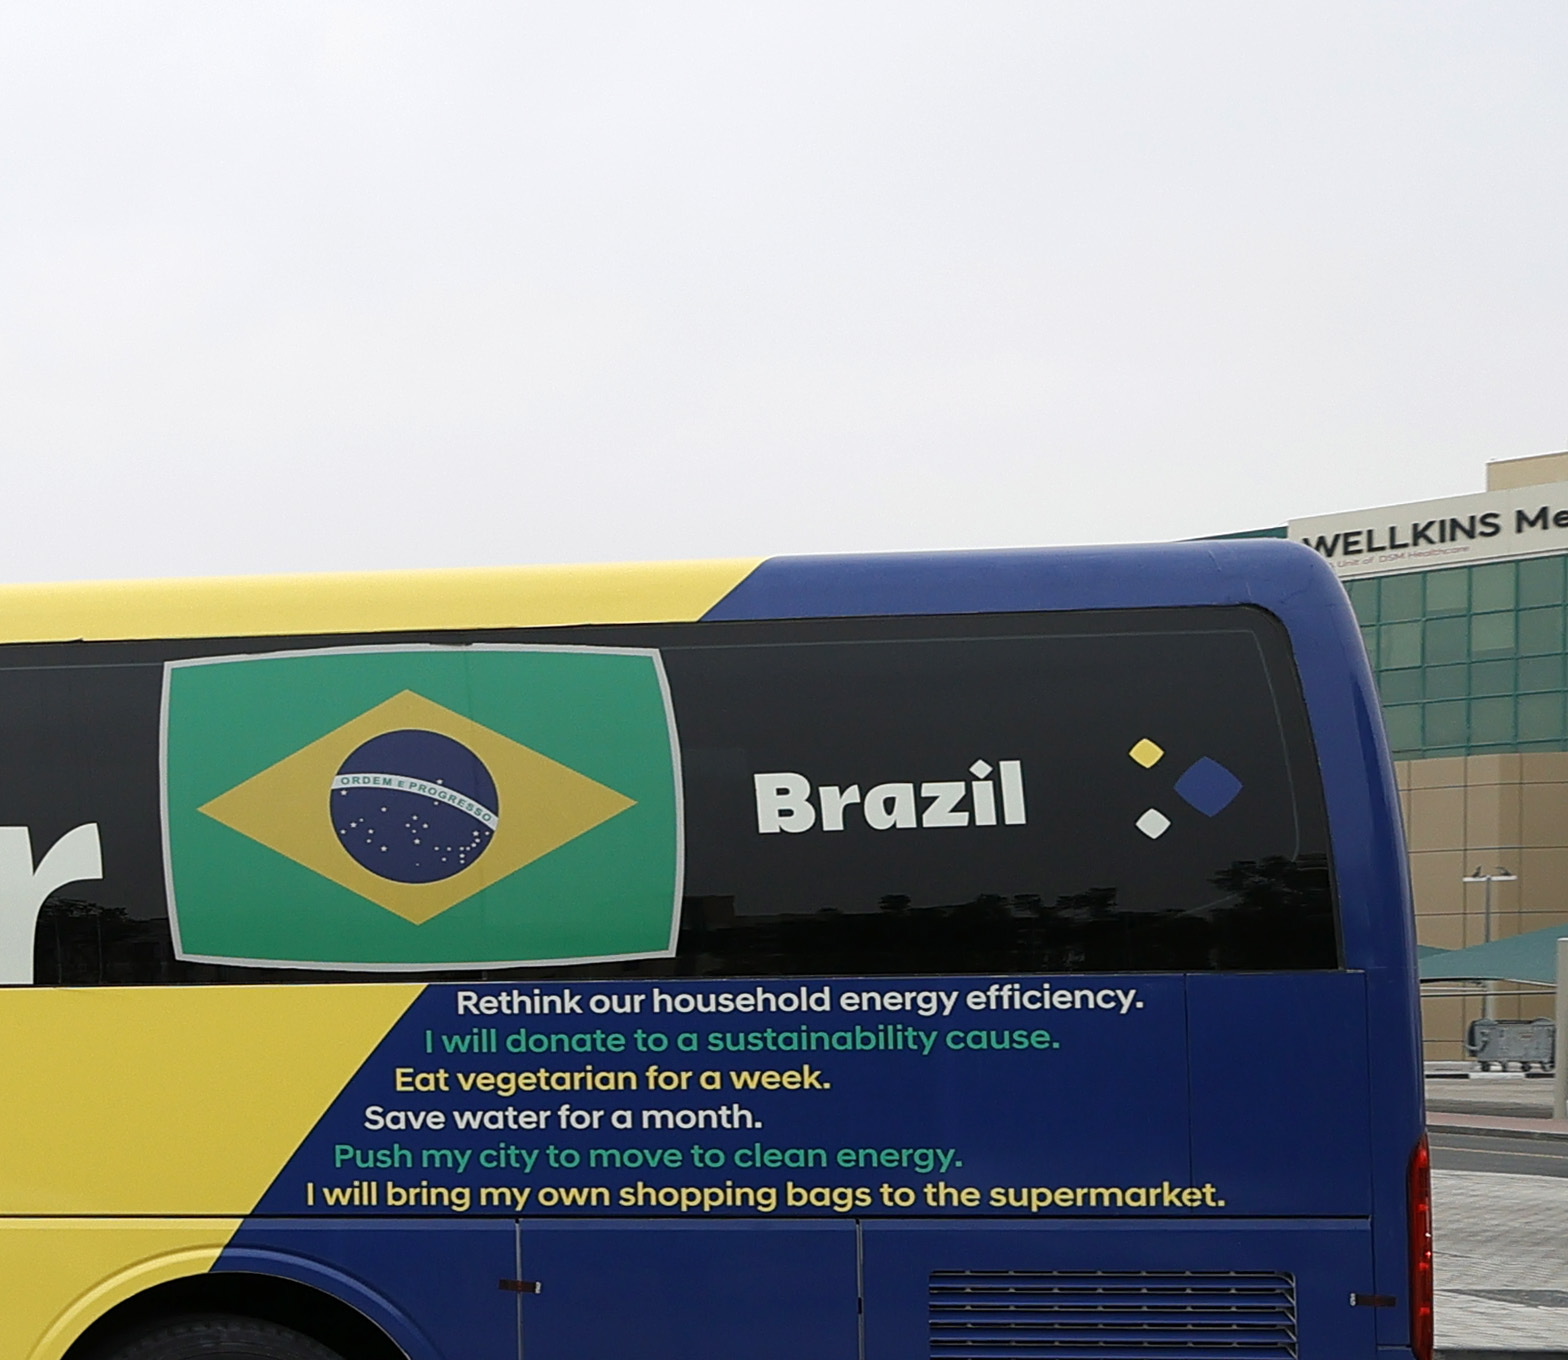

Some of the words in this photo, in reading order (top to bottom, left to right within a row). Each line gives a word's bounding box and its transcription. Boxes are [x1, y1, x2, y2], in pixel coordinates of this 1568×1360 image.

[1303, 513, 1501, 557] WELLKINS
[1515, 506, 1568, 534] Me
[340, 776, 392, 786] ORDEM
[397, 780, 405, 788] E
[409, 780, 492, 823] PROGRESSO
[754, 760, 1027, 834] Brazil
[457, 988, 584, 1015] Rethink
[589, 994, 646, 1014] our
[652, 986, 831, 1013] household
[839, 991, 960, 1017] energy
[966, 982, 1144, 1015] efficiency.
[425, 1030, 433, 1053] I
[441, 1027, 497, 1053] will
[506, 1028, 626, 1053] donate
[633, 1029, 669, 1052] to
[677, 1032, 698, 1052] a
[707, 1024, 938, 1055] sustainability
[945, 1030, 1060, 1050] cause.
[395, 1067, 450, 1092] Eat
[456, 1064, 637, 1097] vegetarian
[645, 1064, 693, 1091] for
[699, 1070, 721, 1090] a
[729, 1063, 831, 1090] week.
[363, 1105, 446, 1130] Save
[452, 1106, 552, 1130] water
[557, 1103, 605, 1130] for
[610, 1110, 633, 1130] a
[641, 1103, 763, 1129] month.
[335, 1143, 413, 1168] Push
[422, 1149, 472, 1173] my
[479, 1142, 540, 1173] city
[545, 1145, 580, 1168] to
[589, 1148, 683, 1168] move
[690, 1144, 725, 1168] to
[734, 1142, 827, 1168] clean
[836, 1148, 963, 1174] energy.
[307, 1182, 314, 1206] I
[322, 1180, 378, 1206] will
[386, 1180, 471, 1212] bring
[480, 1187, 532, 1212] my
[537, 1187, 610, 1207] own
[618, 1180, 777, 1213] shopping
[786, 1181, 872, 1213] bags
[879, 1183, 916, 1207] to
[923, 1181, 981, 1207] the
[989, 1181, 1226, 1213] supermarket.
